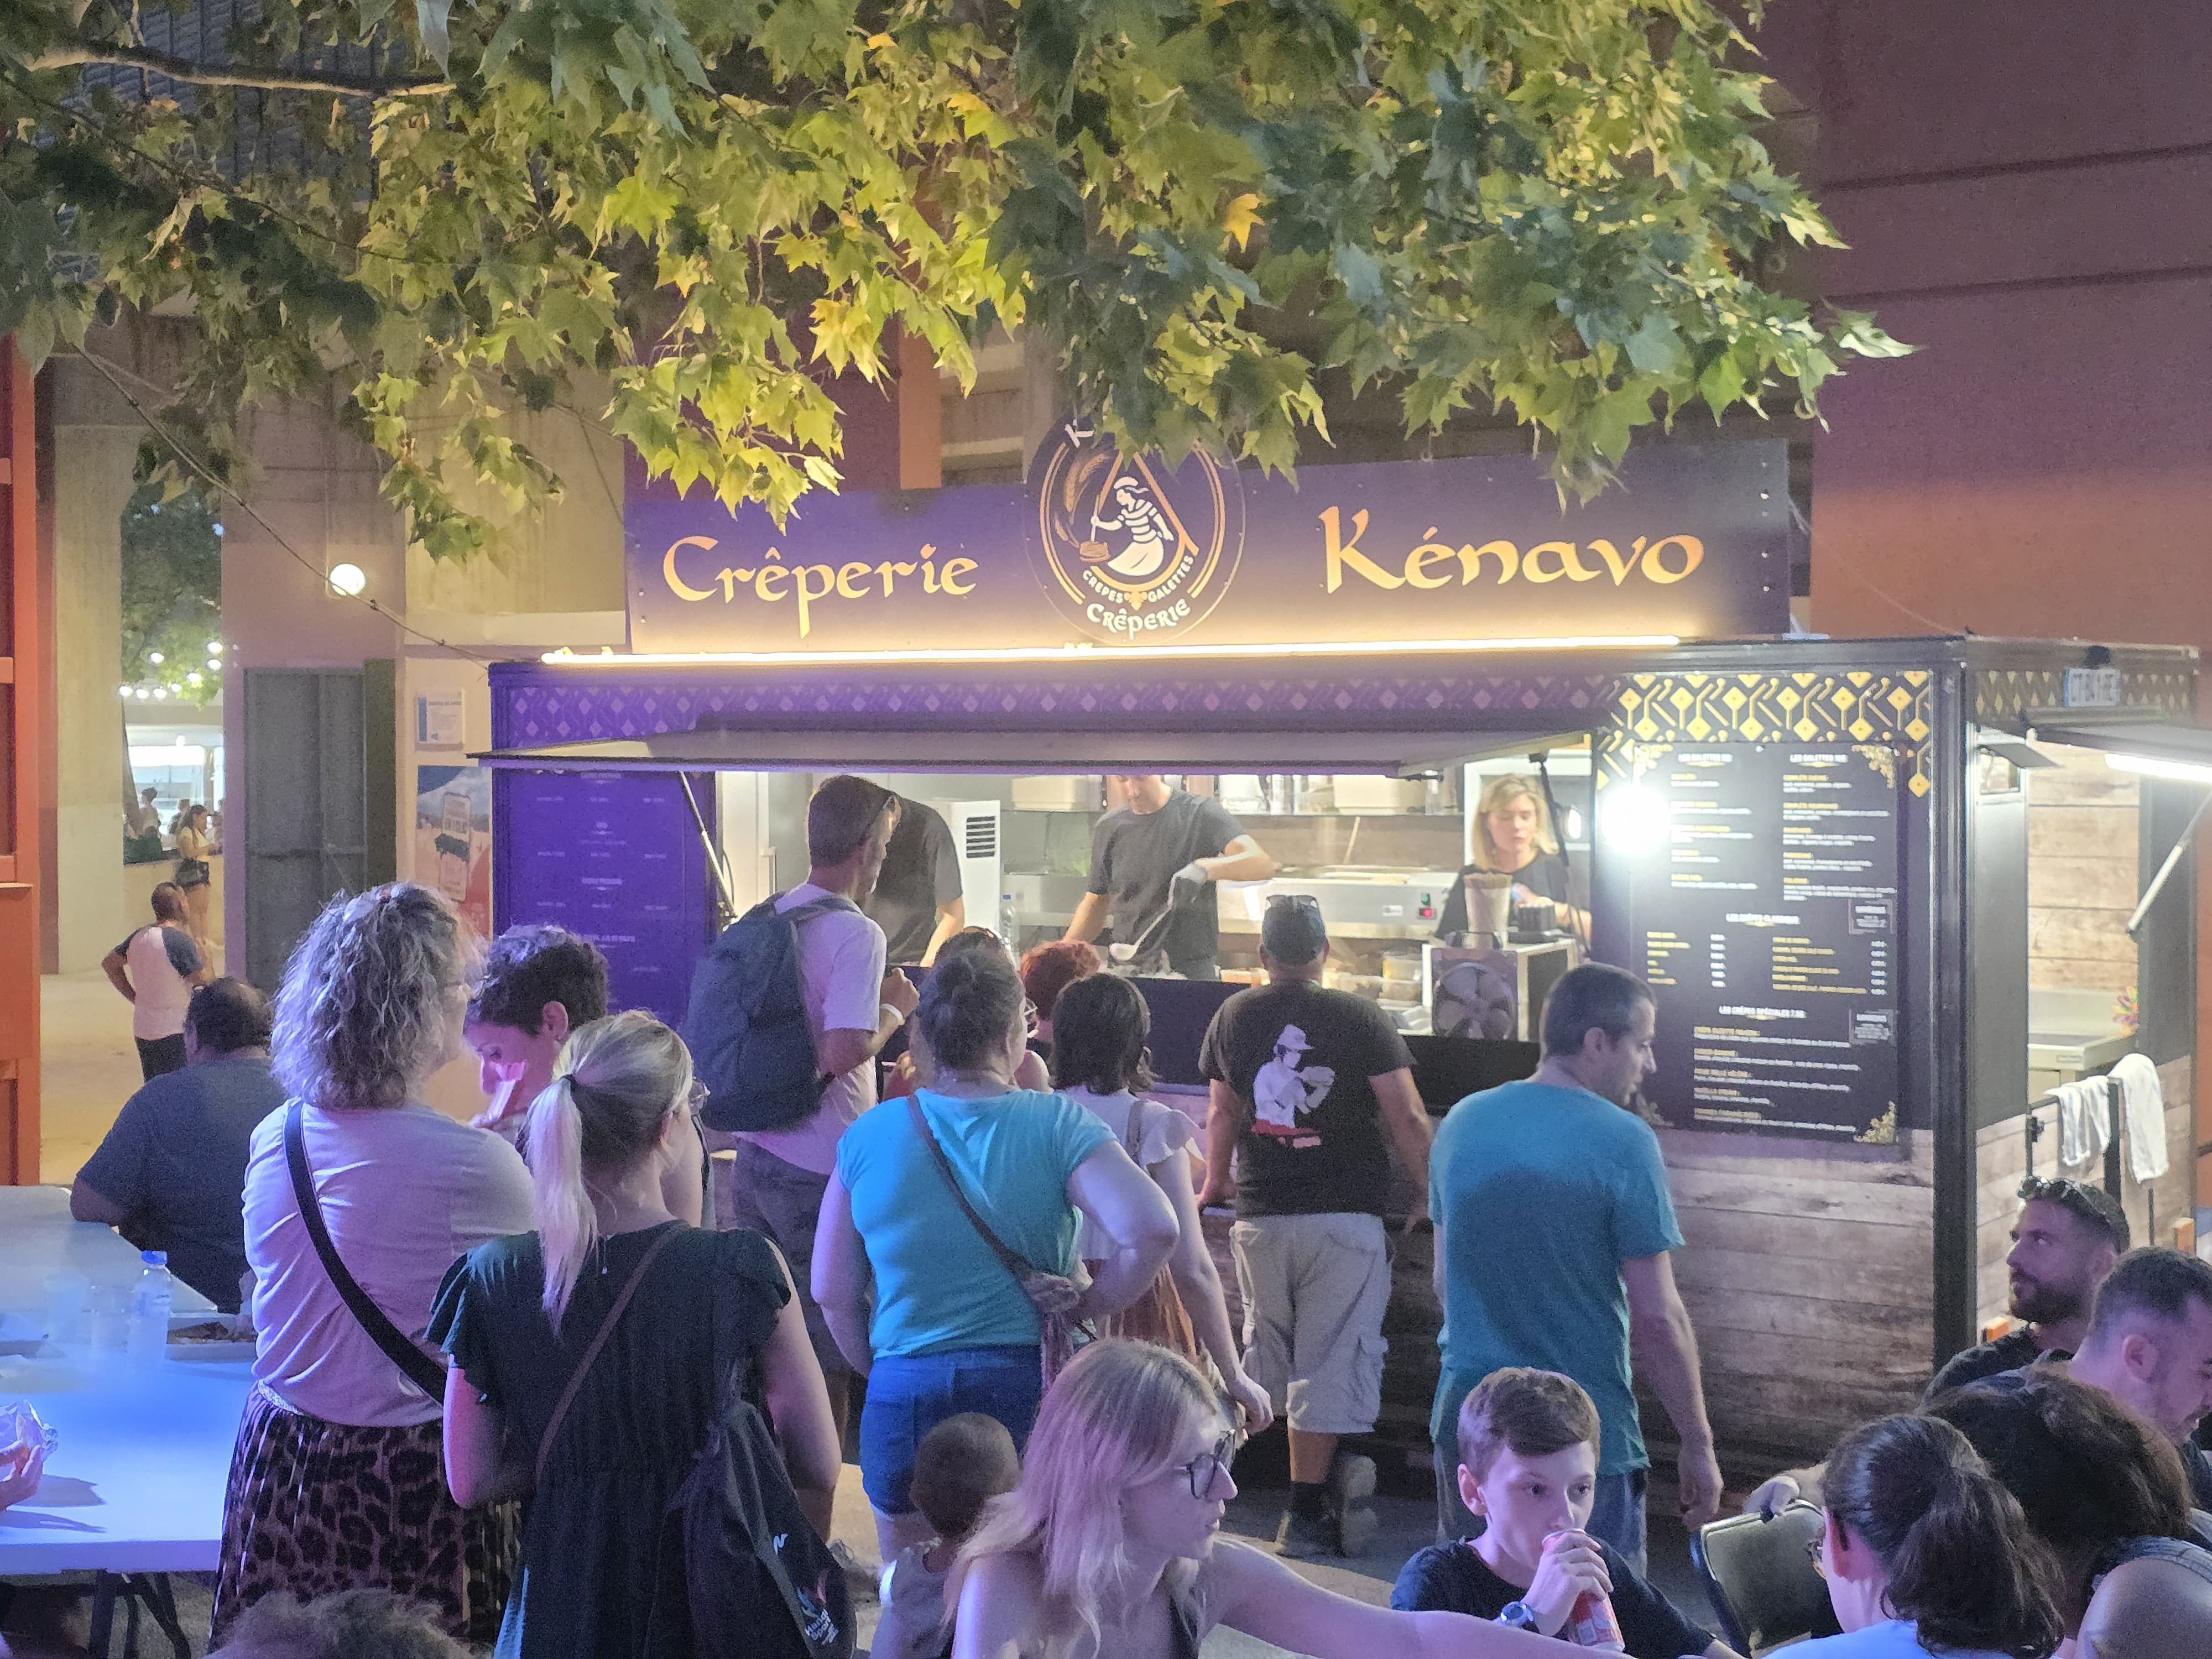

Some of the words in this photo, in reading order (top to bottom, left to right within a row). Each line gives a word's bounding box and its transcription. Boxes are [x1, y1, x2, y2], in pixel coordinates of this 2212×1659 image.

[664, 535, 978, 639] Crêperie
[1318, 505, 1704, 594] Kénavo
[1147, 555, 1194, 603] GALETTES
